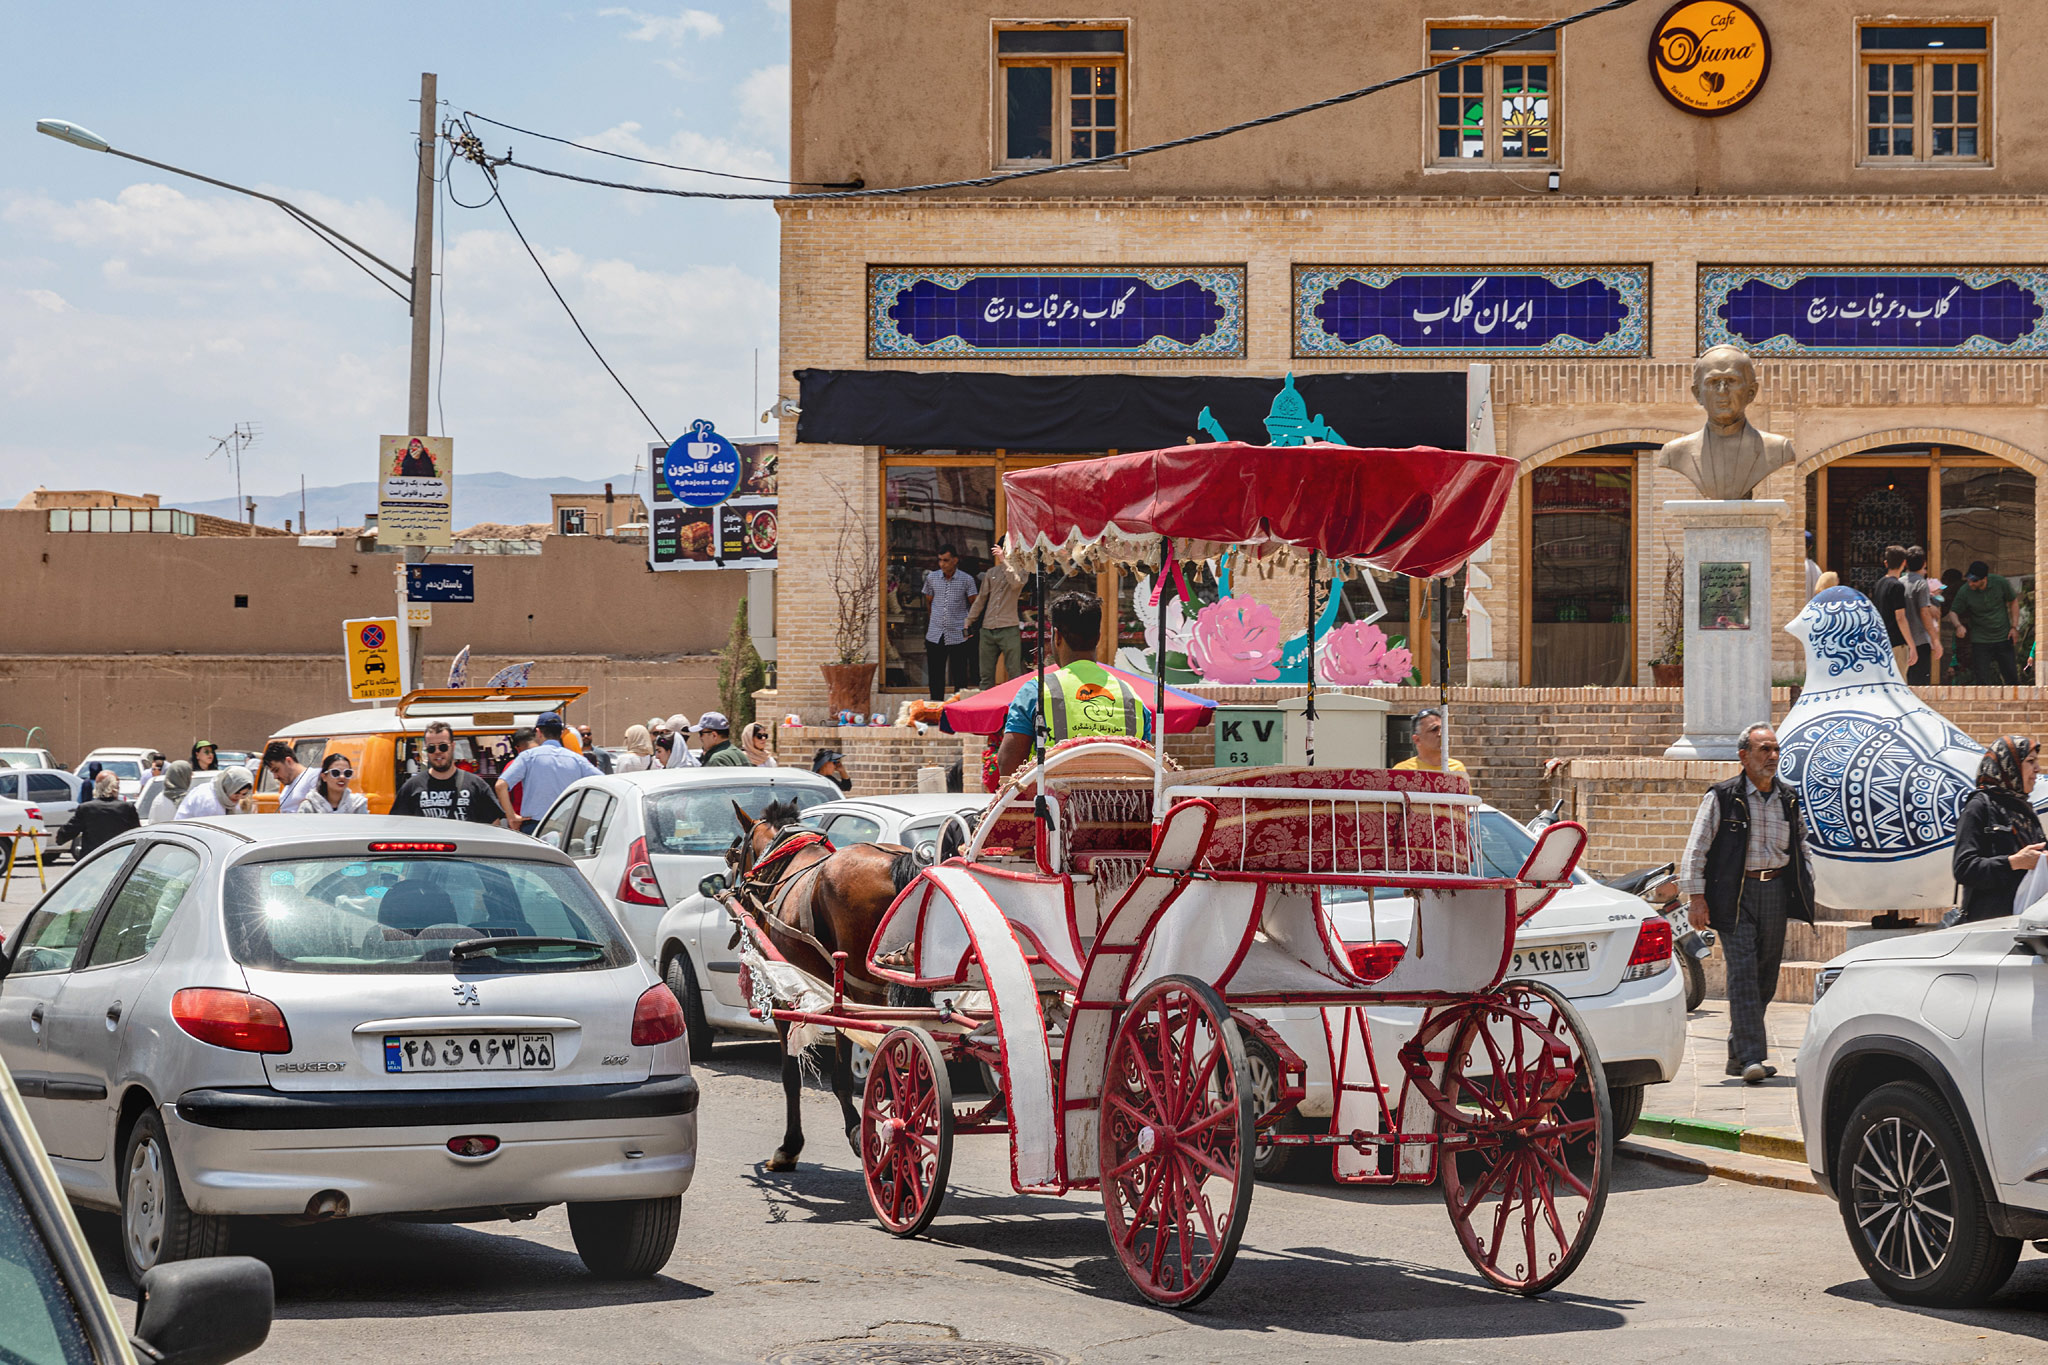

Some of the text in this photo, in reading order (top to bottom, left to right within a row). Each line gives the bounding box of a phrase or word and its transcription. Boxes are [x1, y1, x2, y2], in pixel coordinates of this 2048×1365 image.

[1711, 10, 1736, 31] Cafe
[1671, 85, 1684, 98] Taste
[1684, 95, 1694, 104] the
[1736, 89, 1745, 98] the
[984, 297, 1013, 323] ربیع
[1016, 294, 1073, 327] عرقیات
[1082, 286, 1137, 327] گلاب
[1413, 277, 1533, 335] ایران گلاب
[1807, 296, 1838, 324] ربیع
[1839, 292, 1899, 327] عرقیات
[1907, 285, 1960, 327] گلاب
[668, 461, 709, 477] آقاجون
[710, 461, 735, 473] کافه
[353, 677, 400, 689] ایستگاه تاکسی
[361, 688, 395, 697] TAXI STOP
[1229, 752, 1249, 763] 63
[420, 791, 428, 800] A
[430, 790, 452, 800] DAY
[275, 1061, 347, 1073] PEUGEOT
[601, 1054, 630, 1066] 206
